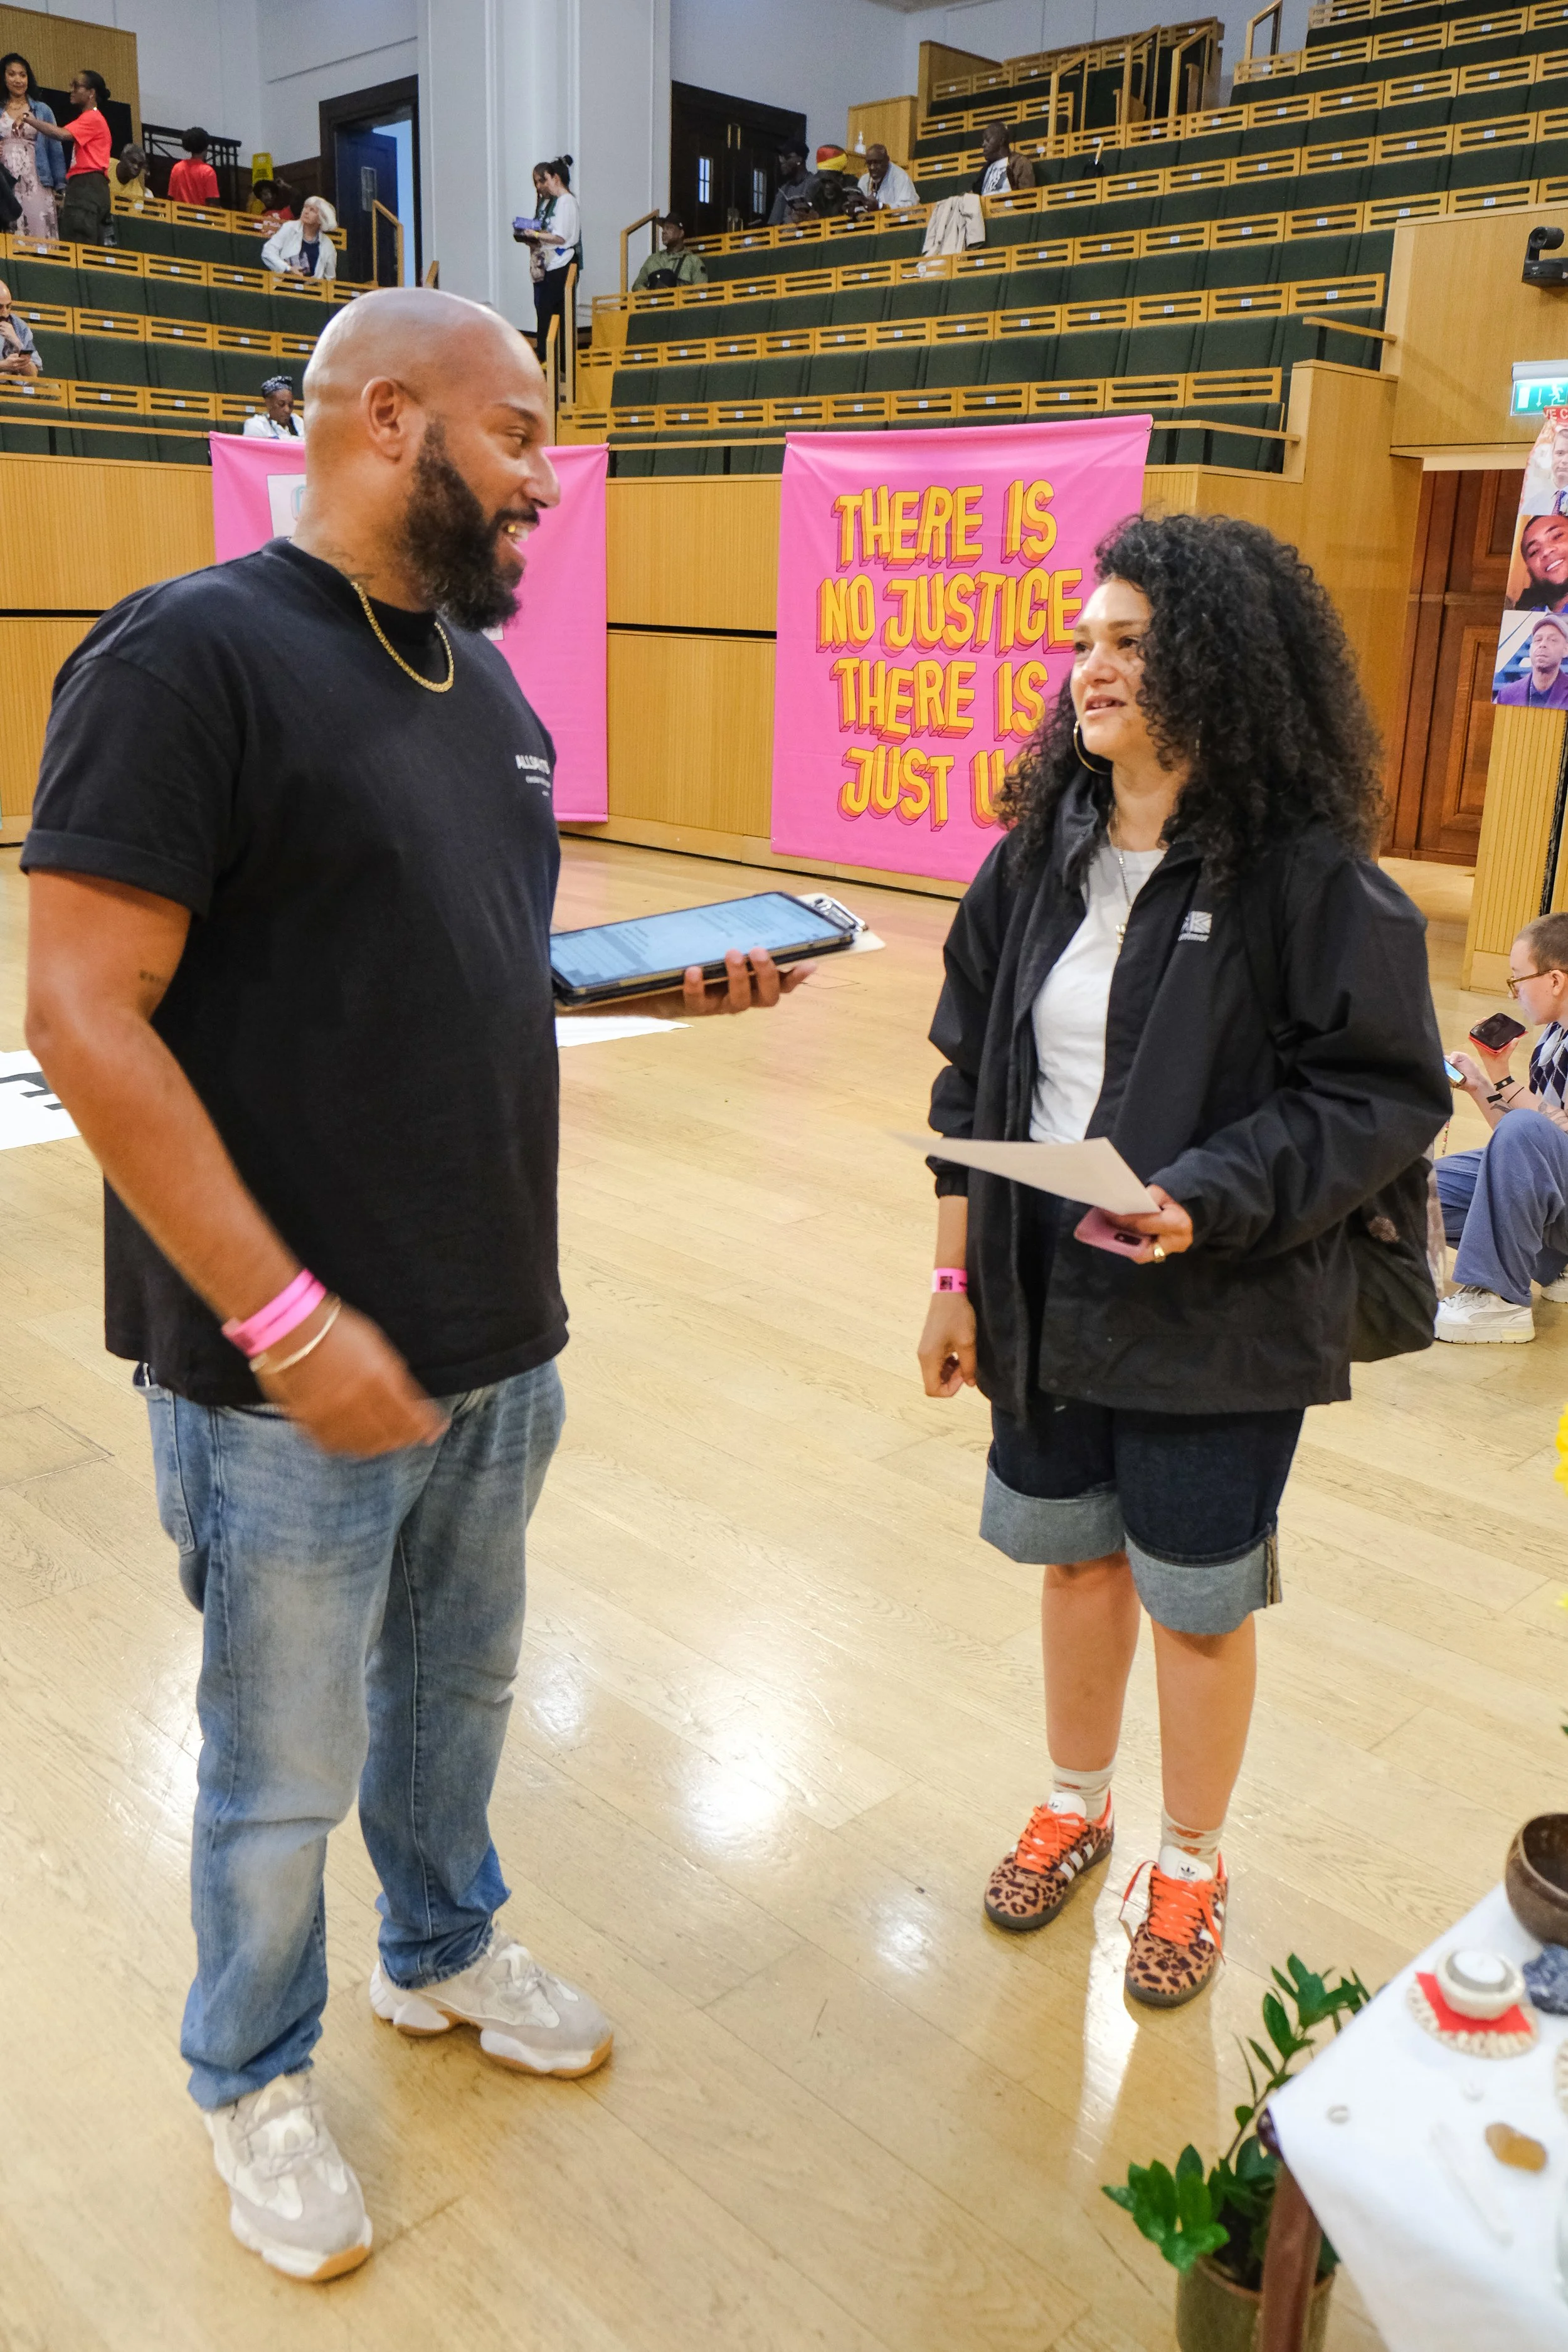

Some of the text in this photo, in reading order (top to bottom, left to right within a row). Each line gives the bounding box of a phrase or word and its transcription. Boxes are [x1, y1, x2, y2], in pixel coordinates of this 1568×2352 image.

[830, 479, 1058, 572] THERE IS
[816, 568, 1083, 657] NO JUSTICE
[829, 657, 1049, 744] THERE IS
[837, 744, 955, 832] JUST
